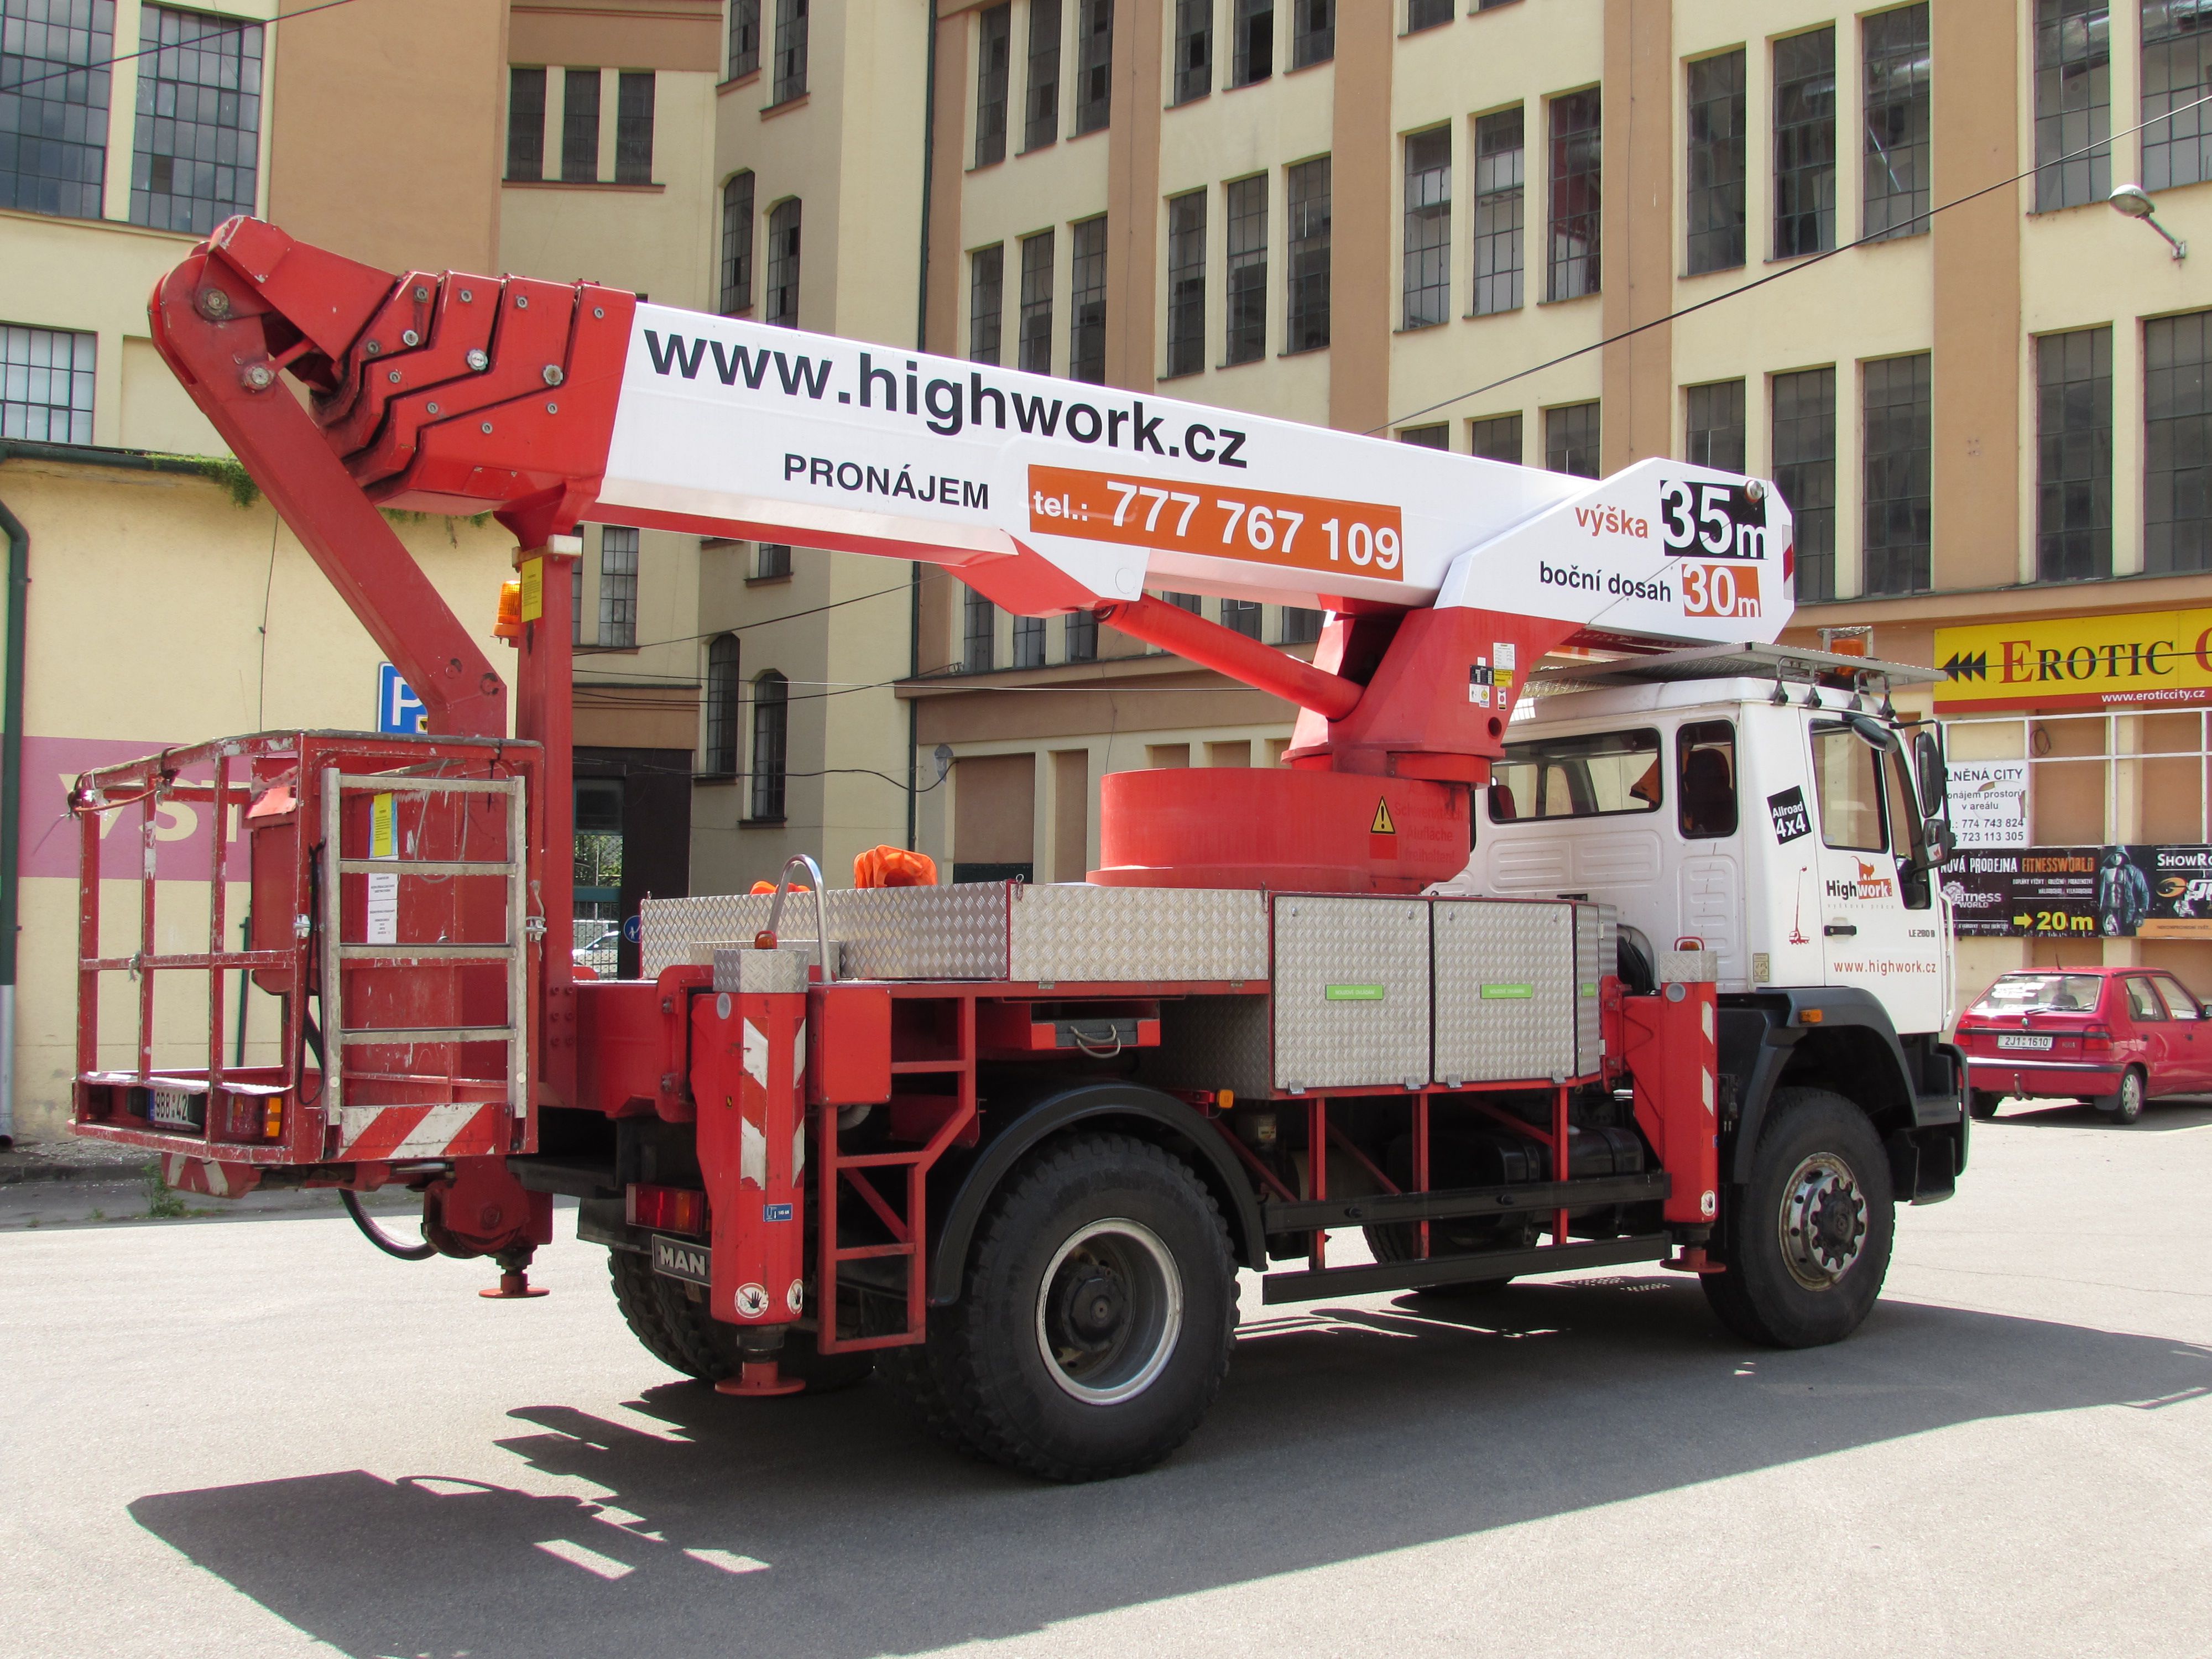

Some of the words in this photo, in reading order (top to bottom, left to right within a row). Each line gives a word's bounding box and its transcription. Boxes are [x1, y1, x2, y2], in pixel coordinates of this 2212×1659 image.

[644, 329, 1247, 468] www.highwork.cz
[784, 453, 989, 510] PRONÁJEM
[1033, 490, 1088, 521] tel.:
[1107, 481, 1200, 537] 777
[1217, 500, 1303, 553] 767
[1322, 518, 1400, 570] 109
[1575, 504, 1648, 539] výška
[1540, 561, 1601, 591] boční
[1608, 573, 1671, 603] dosah
[392, 676, 423, 726] P
[2101, 688, 2206, 702] www.eroticcity.cz
[1994, 769, 2023, 780] CITY
[1773, 801, 1803, 818] Allroad
[1776, 813, 1806, 837] 4x4
[1961, 819, 1979, 828] 774
[1984, 818, 2002, 828] 743
[2005, 818, 2024, 827] 824
[1961, 832, 1980, 841] 723
[1984, 832, 2001, 841] 113
[2005, 832, 2024, 841] 305
[1969, 858, 2017, 873] PRODEJNA
[2022, 857, 2094, 873] FITNESSWORLD
[1826, 880, 1889, 900] Highwork
[2036, 911, 2067, 930] 20
[2070, 916, 2094, 930] m
[1834, 959, 1936, 976] www.highwork.cz
[660, 1244, 706, 1276] MAN
